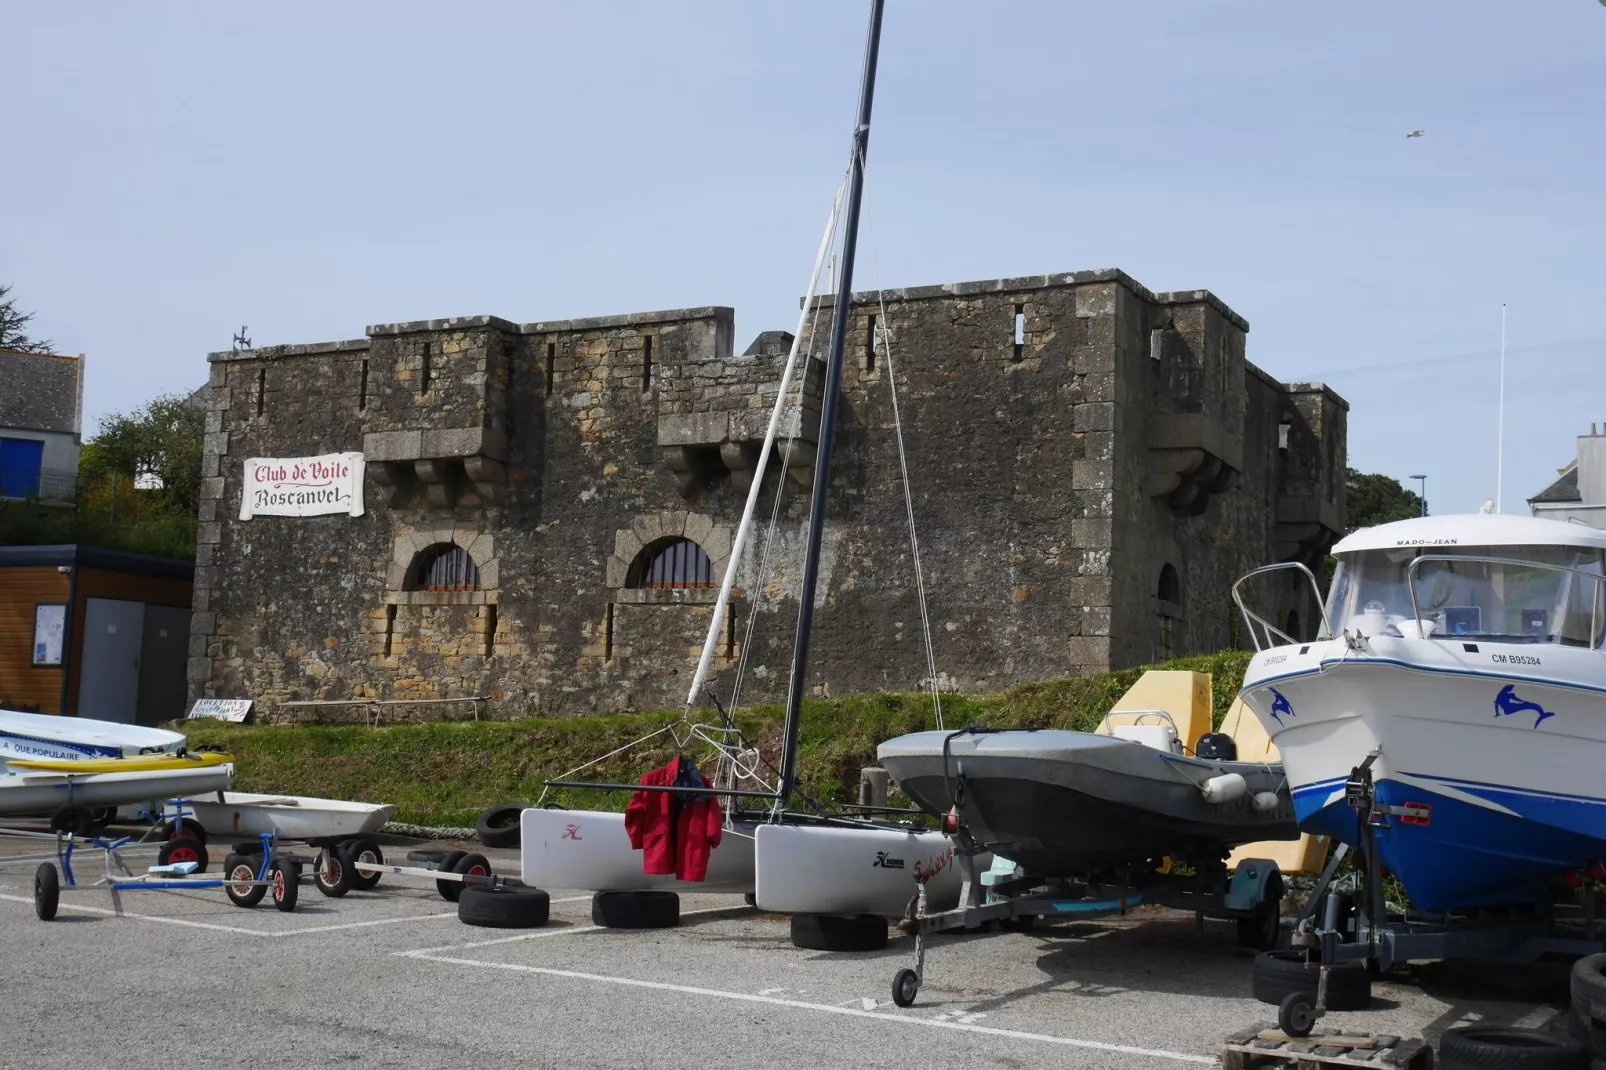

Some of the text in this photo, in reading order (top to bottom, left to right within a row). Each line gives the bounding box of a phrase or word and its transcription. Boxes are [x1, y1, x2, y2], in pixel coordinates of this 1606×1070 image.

[255, 461, 349, 482] Club de Voile
[255, 487, 351, 508] Roscanvel
[1491, 654, 1541, 665] CM B95284
[32, 747, 81, 761] POPULAIRE
